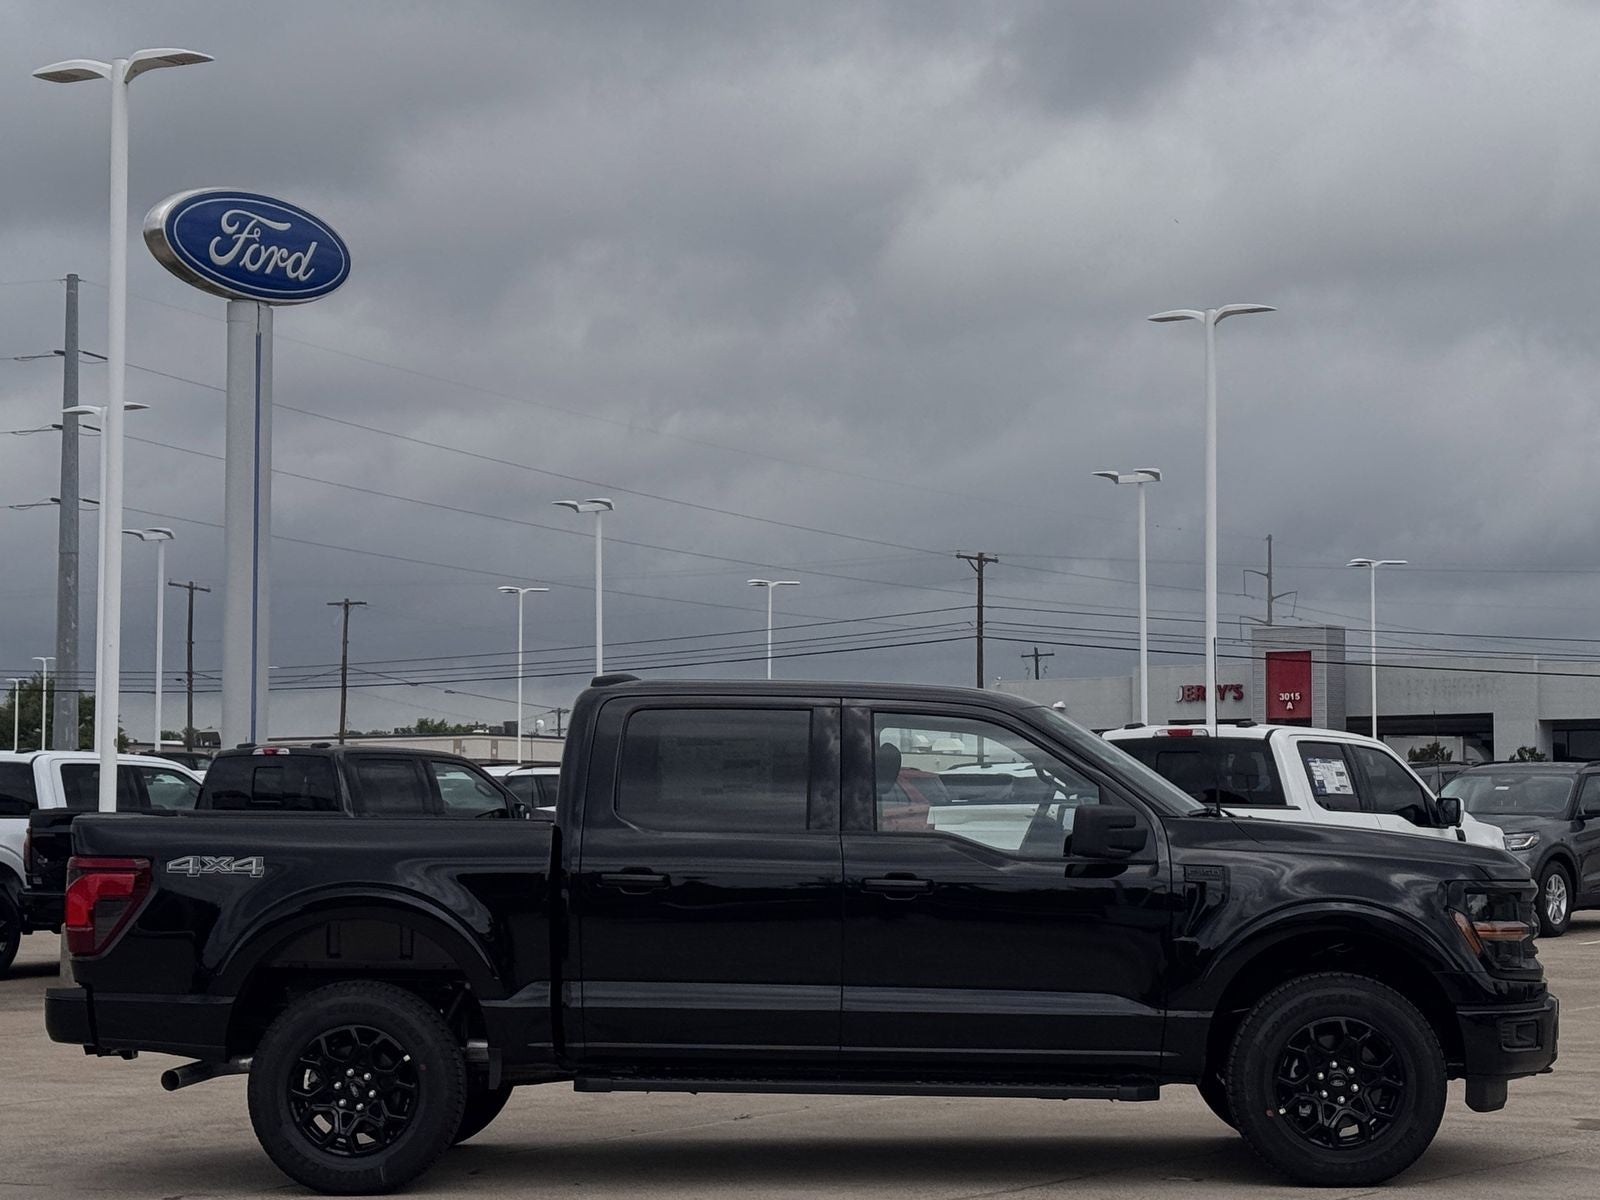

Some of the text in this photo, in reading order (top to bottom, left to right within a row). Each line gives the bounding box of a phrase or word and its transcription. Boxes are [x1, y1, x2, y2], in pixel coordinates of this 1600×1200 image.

[208, 209, 318, 281] Ford
[1176, 684, 1244, 703] JERY'S
[1279, 692, 1301, 701] 3015
[1286, 701, 1294, 710] A
